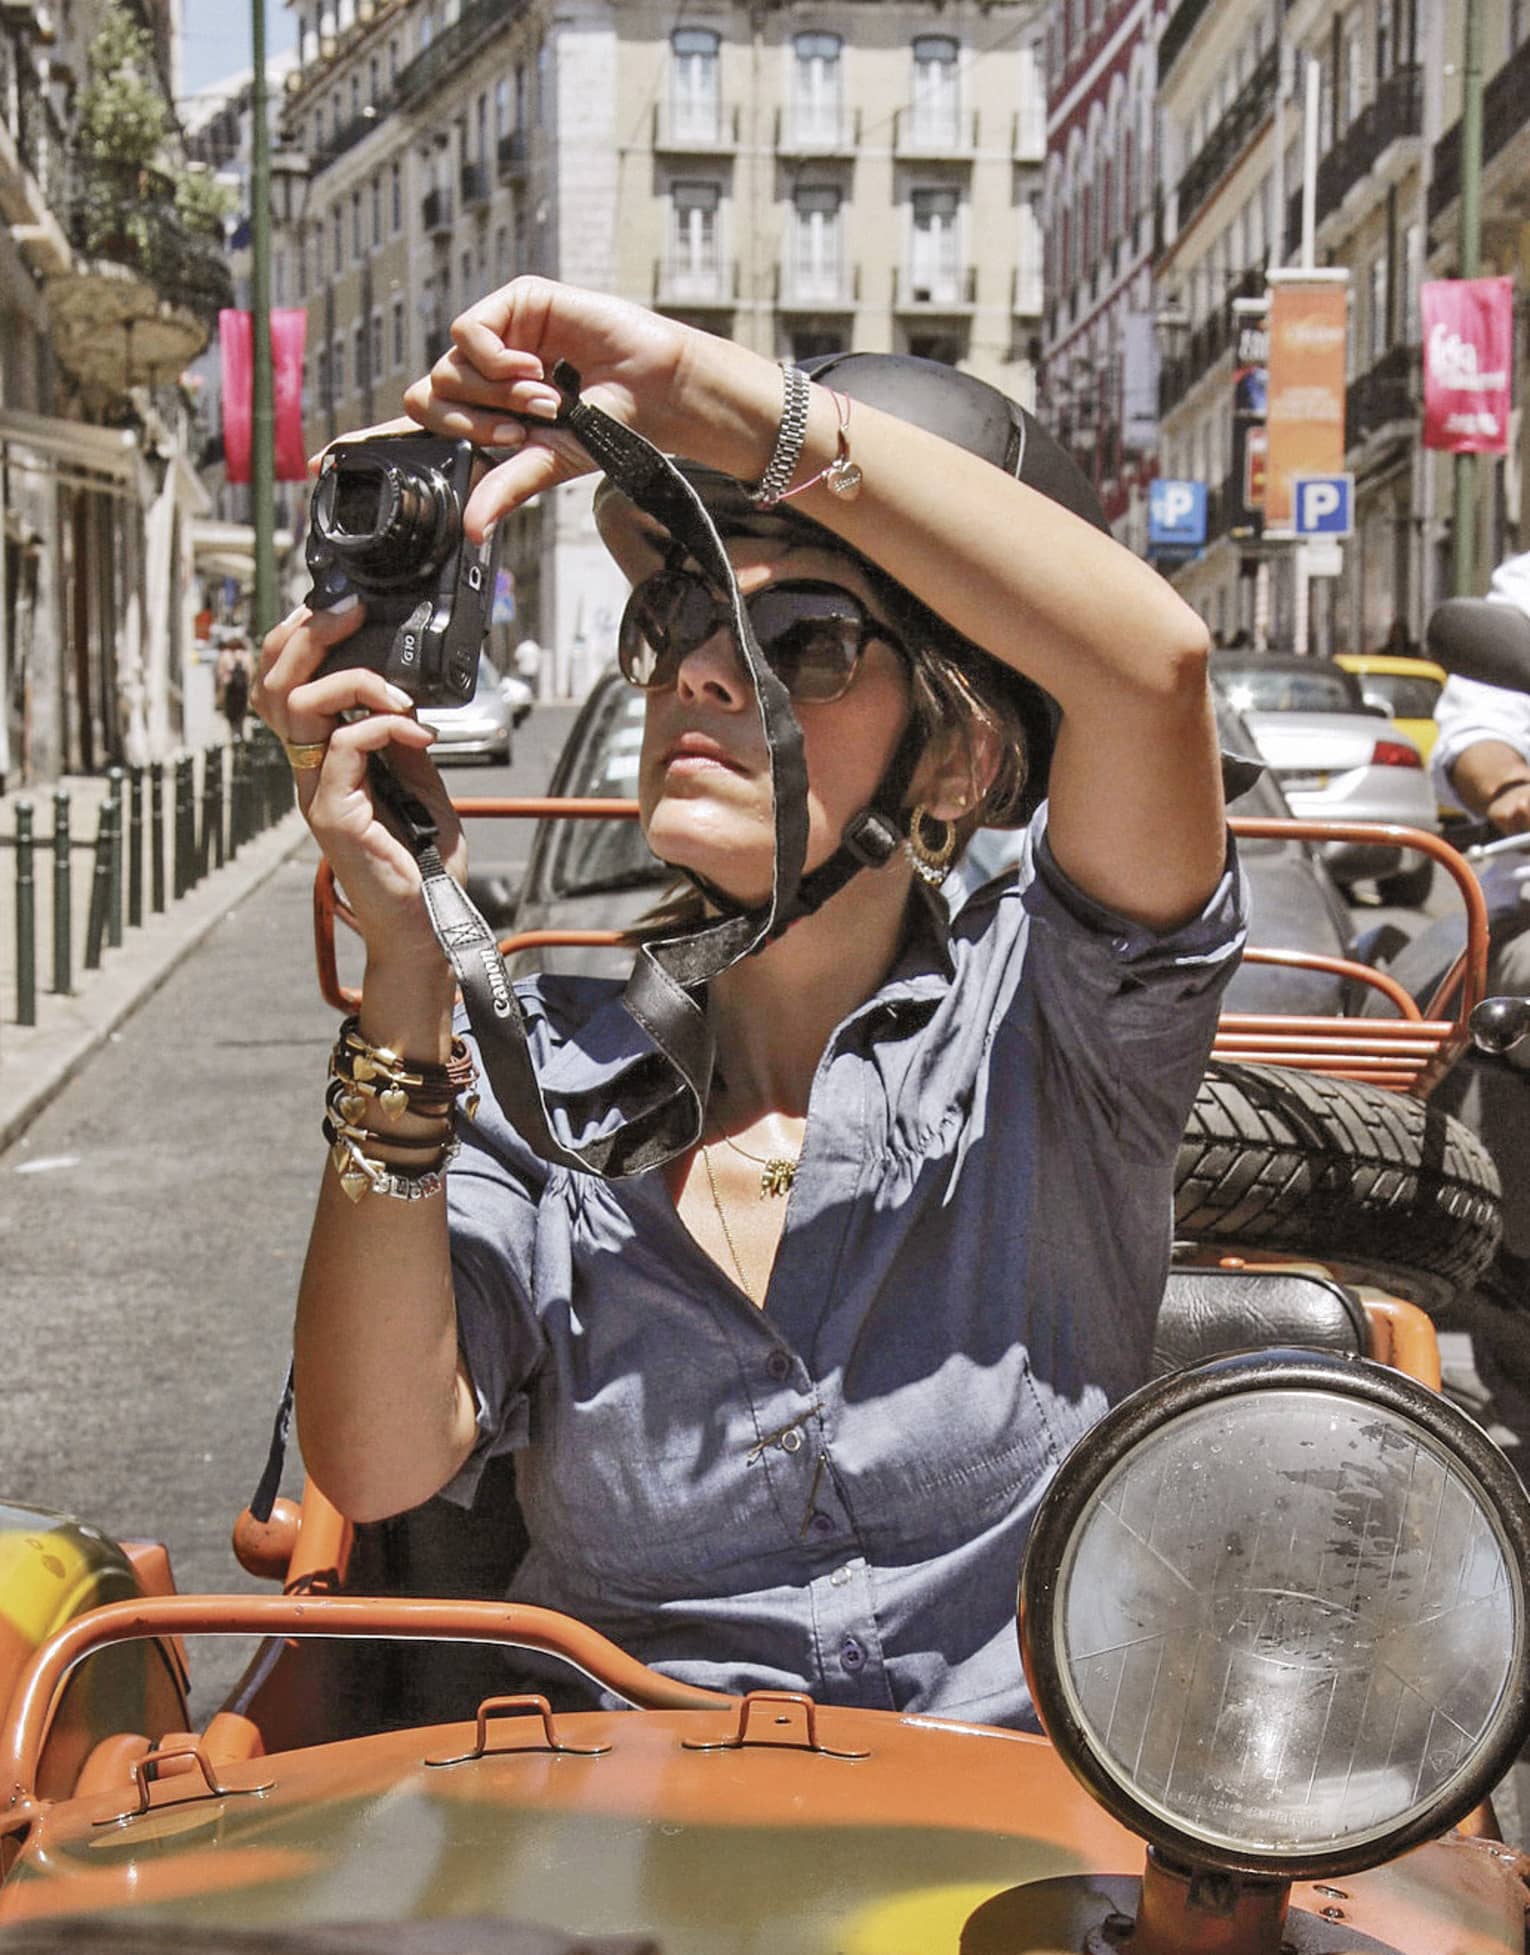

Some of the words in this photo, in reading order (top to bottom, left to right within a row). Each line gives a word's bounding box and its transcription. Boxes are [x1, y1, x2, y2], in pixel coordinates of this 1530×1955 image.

[1304, 483, 1340, 530] P
[404, 634, 415, 661] G10
[480, 950, 511, 1018] Canon
